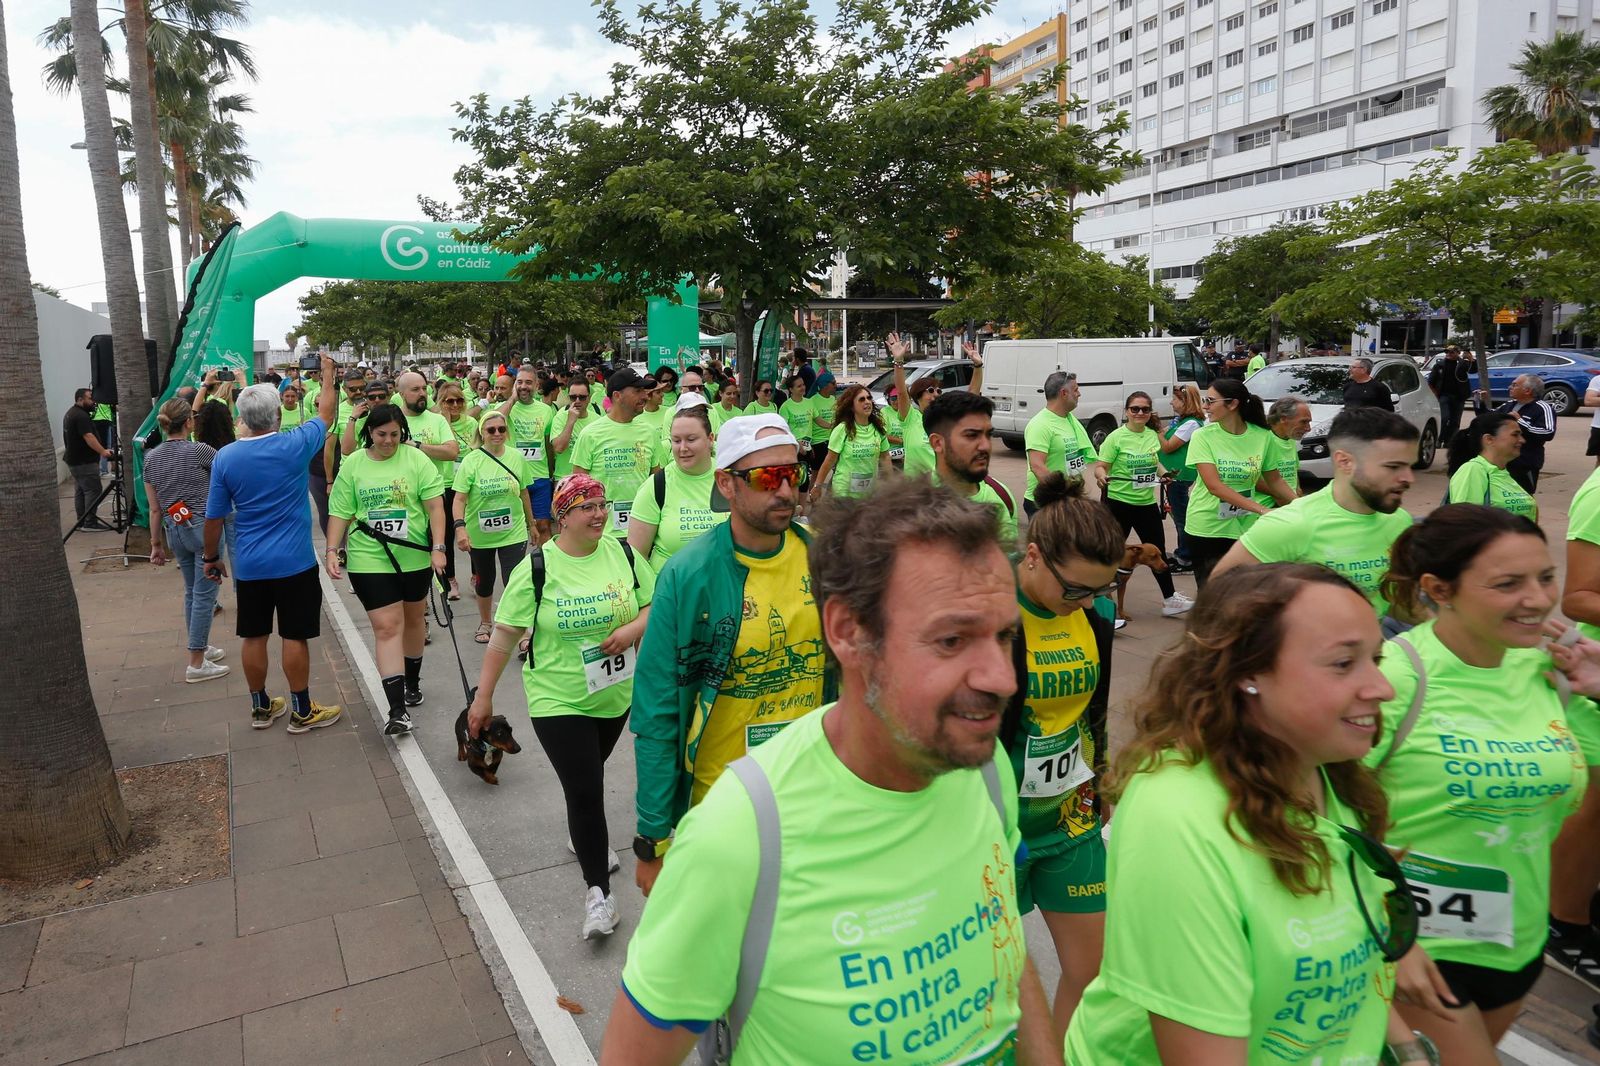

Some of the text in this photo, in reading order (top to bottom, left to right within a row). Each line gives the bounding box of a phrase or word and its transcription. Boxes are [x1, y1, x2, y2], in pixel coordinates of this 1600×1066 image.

[437, 243, 479, 254] contra
[456, 258, 491, 269] Cádiz
[659, 347, 671, 355] En
[660, 357, 693, 365] marha
[522, 448, 536, 457] 77
[615, 446, 641, 454] marcha
[480, 483, 501, 491] contra
[361, 494, 384, 503] contra
[484, 515, 511, 528] 458
[618, 511, 631, 523] 5
[680, 515, 713, 523] contra
[374, 520, 404, 532] 457
[680, 523, 691, 531] el
[1349, 556, 1389, 571] march
[556, 591, 619, 607] En marcha
[557, 606, 597, 619] contra
[557, 614, 615, 630] el cáncer
[1034, 646, 1086, 666] RUNNERS
[600, 653, 626, 676] 19
[1026, 660, 1101, 700] ARREÑ
[750, 731, 771, 739] contra
[1438, 734, 1578, 755] En marcha
[1037, 743, 1080, 784] 107
[1444, 760, 1542, 778] contra
[1446, 779, 1573, 800] el cáncer
[840, 952, 894, 990] En
[903, 896, 1004, 975] marcha
[1294, 956, 1333, 982] En
[848, 967, 962, 1027] contra
[852, 1029, 893, 1063] el
[902, 977, 999, 1054] cáncer
[1273, 1001, 1306, 1025] el
